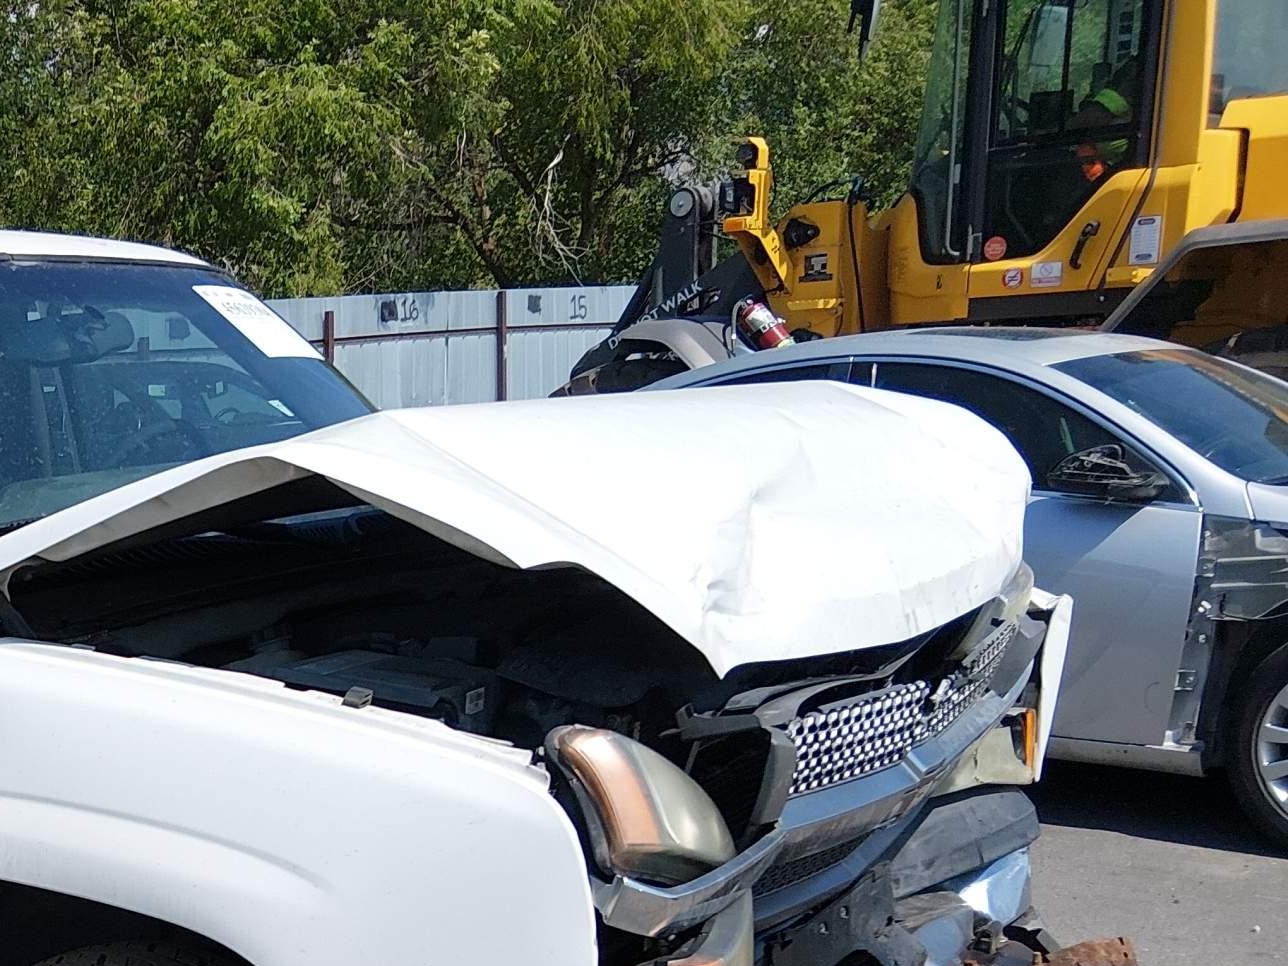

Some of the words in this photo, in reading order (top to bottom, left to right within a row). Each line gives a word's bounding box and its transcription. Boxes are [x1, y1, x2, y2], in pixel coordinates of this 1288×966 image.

[569, 294, 588, 320] 15
[661, 280, 703, 312] WALK
[400, 298, 420, 322] 16
